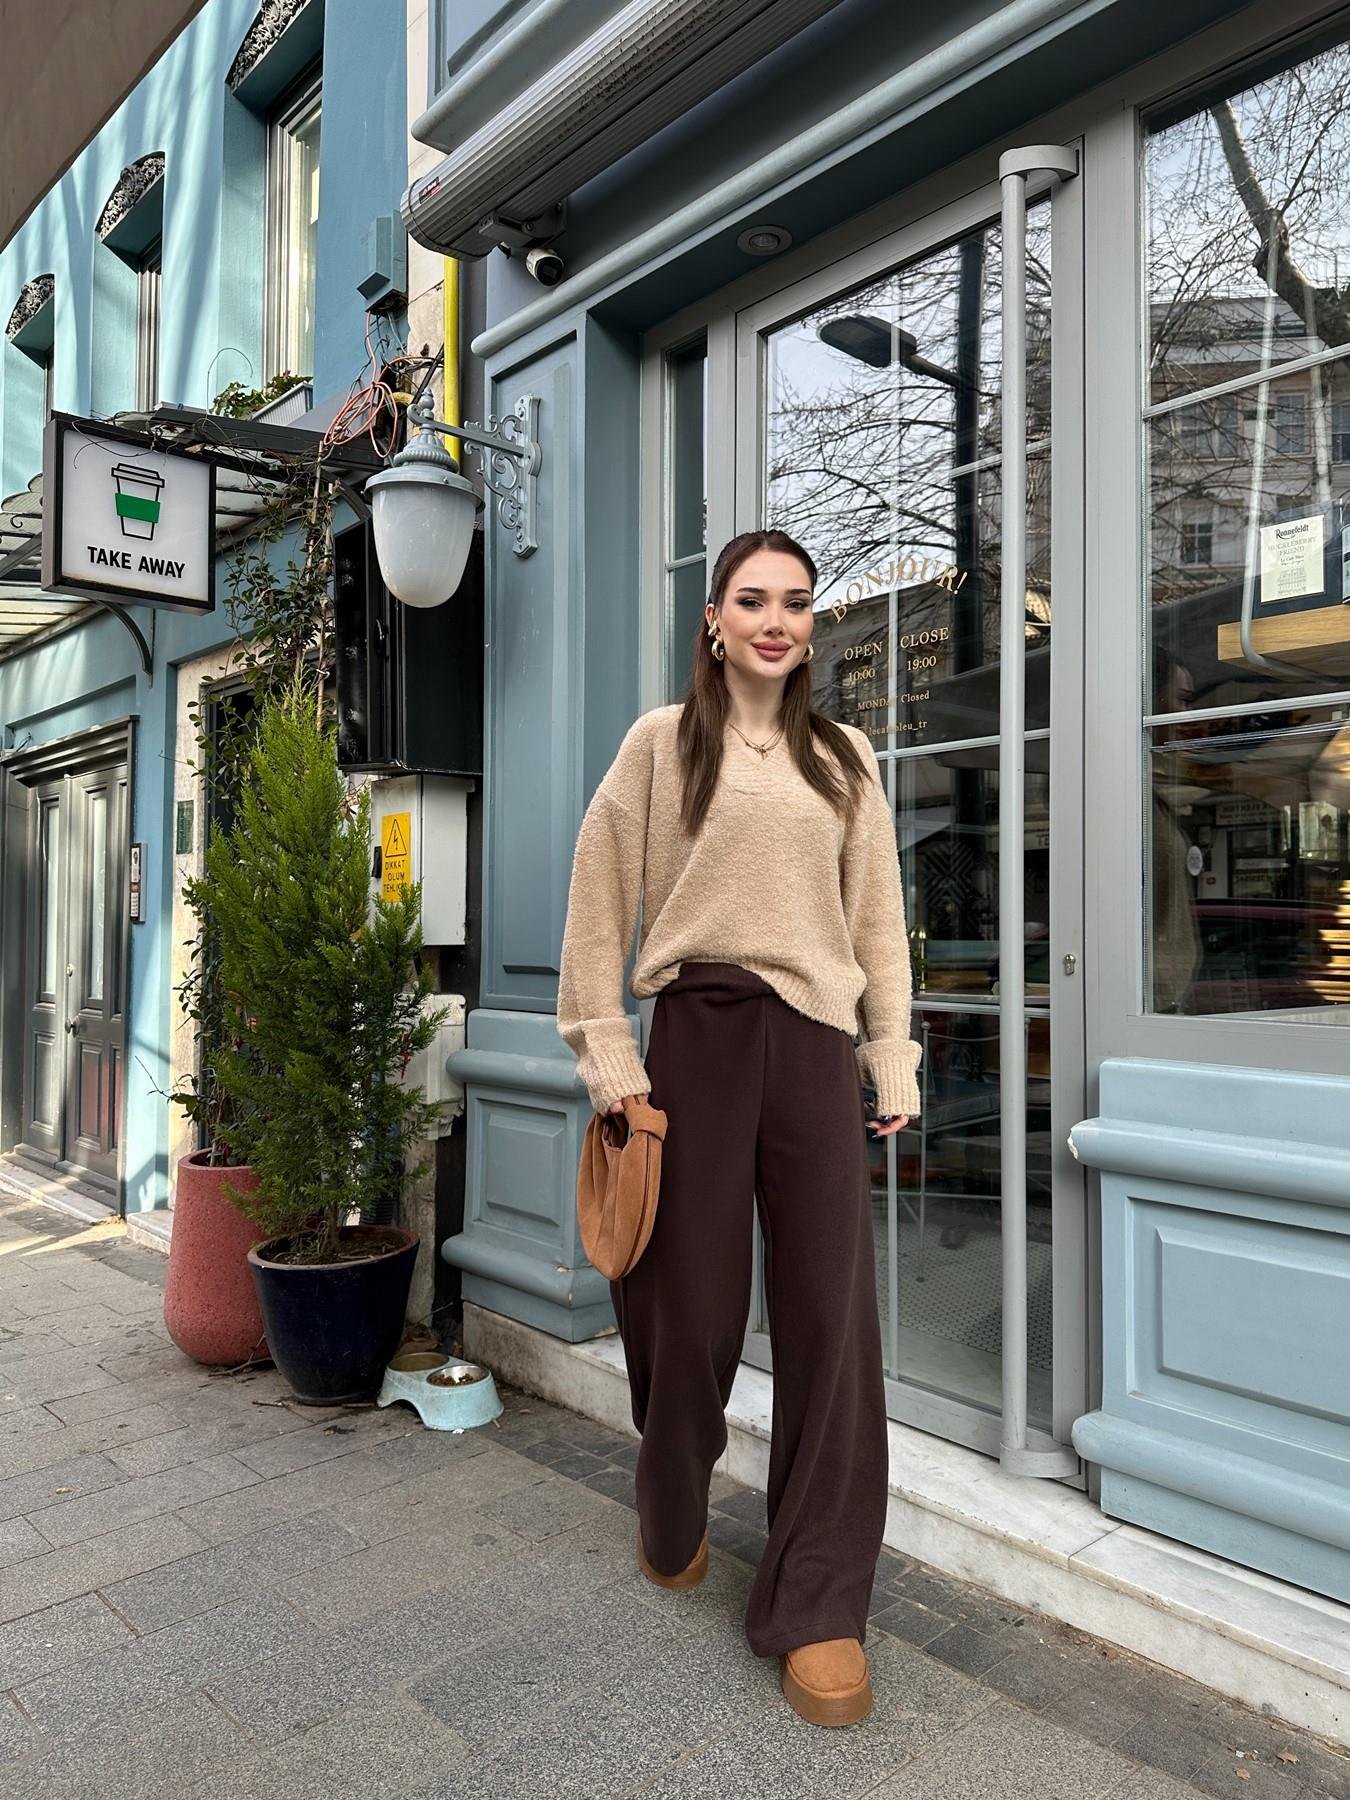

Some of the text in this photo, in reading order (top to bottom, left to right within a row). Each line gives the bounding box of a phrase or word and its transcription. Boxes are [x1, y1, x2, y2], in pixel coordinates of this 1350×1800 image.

[1275, 525, 1309, 540] Ronnefeldt
[87, 546, 185, 579] TAKE AWAY
[830, 554, 967, 623] BONJOUR!
[844, 627, 949, 660] OPEN CLOSE
[848, 655, 936, 683] 10:00 19:00
[901, 690, 930, 704] Closed
